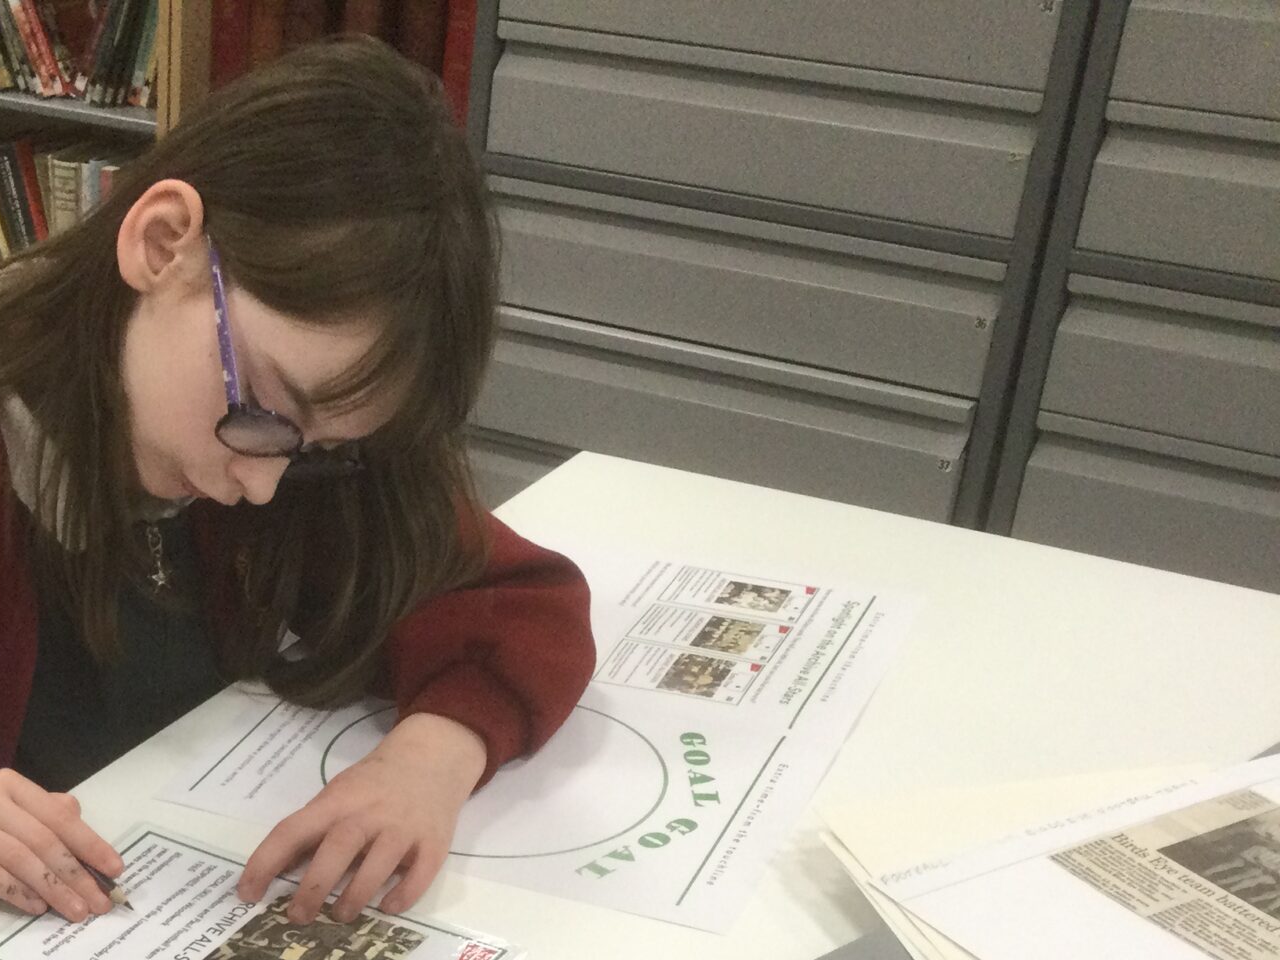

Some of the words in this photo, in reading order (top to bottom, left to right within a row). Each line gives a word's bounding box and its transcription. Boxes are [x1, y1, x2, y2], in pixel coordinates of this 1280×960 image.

[679, 731, 721, 808] GOAL
[574, 817, 699, 880] GOAL
[1110, 831, 1151, 860] Birds
[1147, 855, 1180, 876] Eye
[1176, 873, 1217, 899] team
[1214, 893, 1280, 934] battered
[204, 901, 257, 938] RCHIVE
